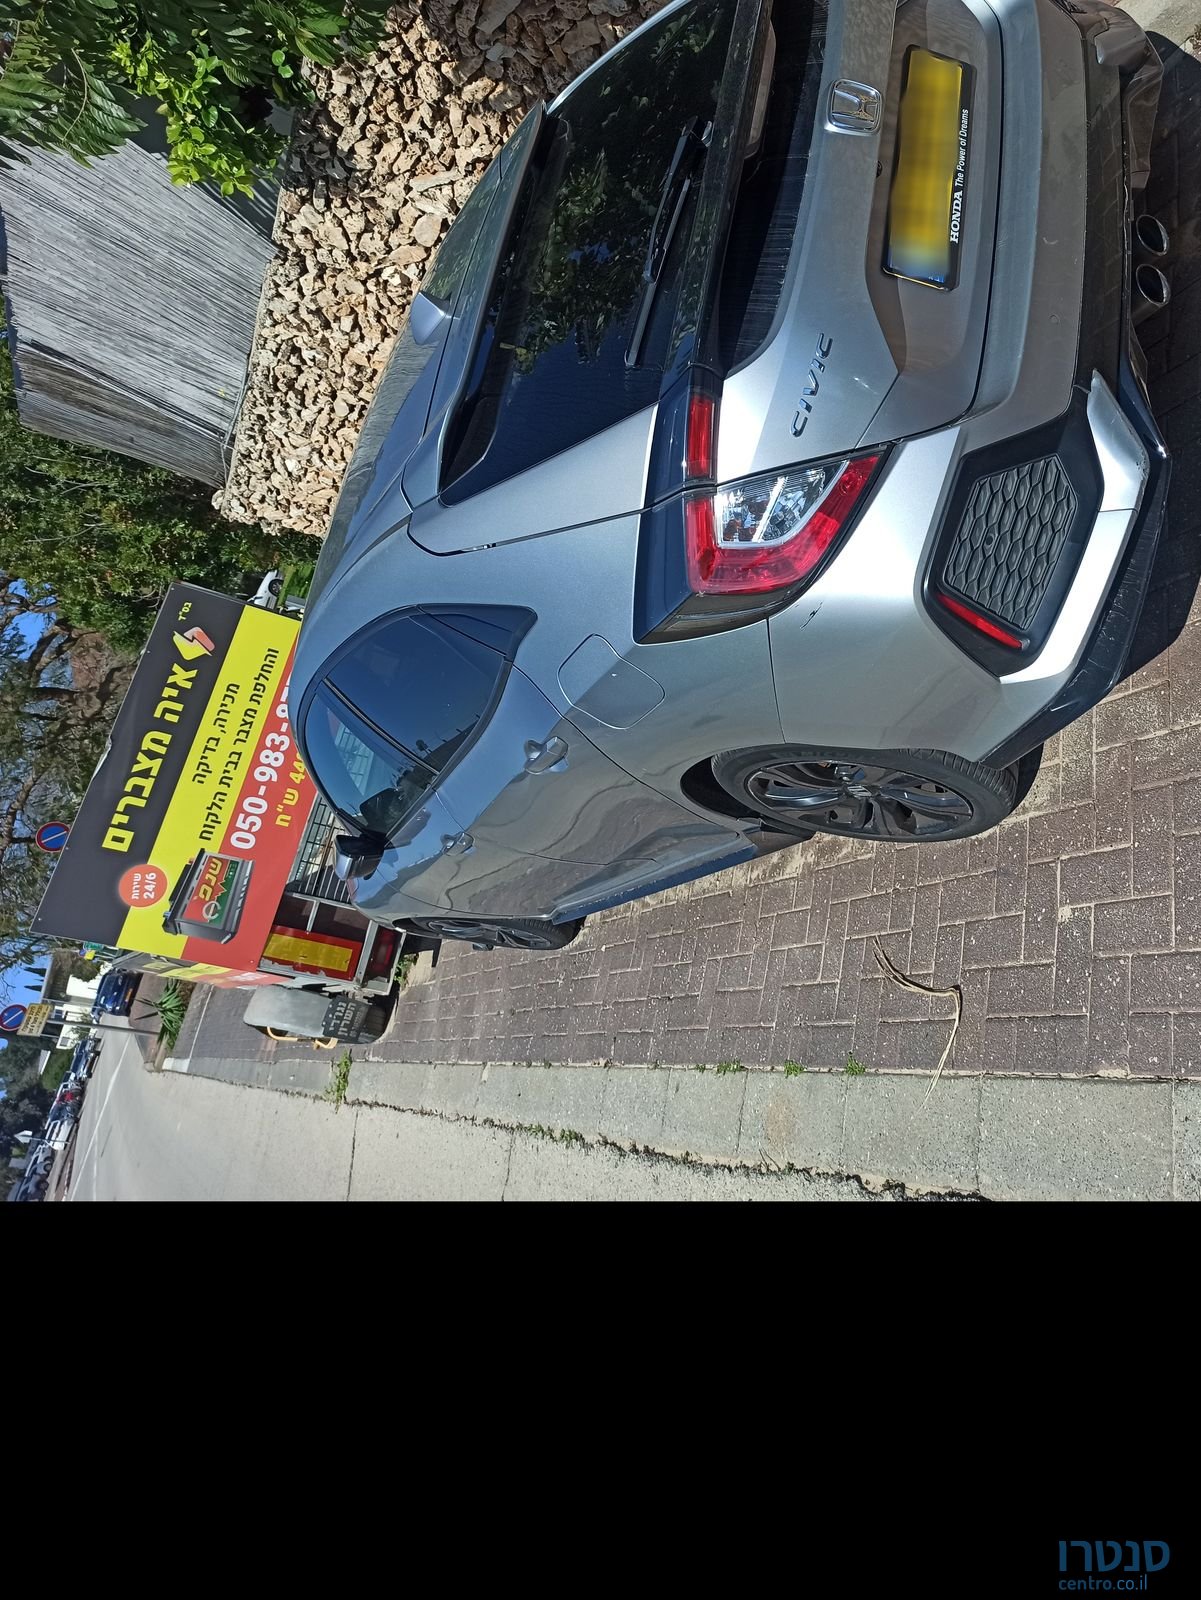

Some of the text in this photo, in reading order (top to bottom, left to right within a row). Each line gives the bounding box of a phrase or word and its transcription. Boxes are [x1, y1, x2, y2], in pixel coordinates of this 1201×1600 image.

[949, 109, 969, 244] HONDA The Power of Dreams
[789, 332, 833, 438] CIVIC
[101, 663, 198, 852] איה מצברים
[191, 683, 240, 785] מכירה, בדיקה
[197, 648, 279, 841] והחלפת מצבר בבית הלקוח
[230, 671, 292, 850] 050-983-8
[131, 873, 142, 900] שירות
[143, 872, 157, 899] 24/6
